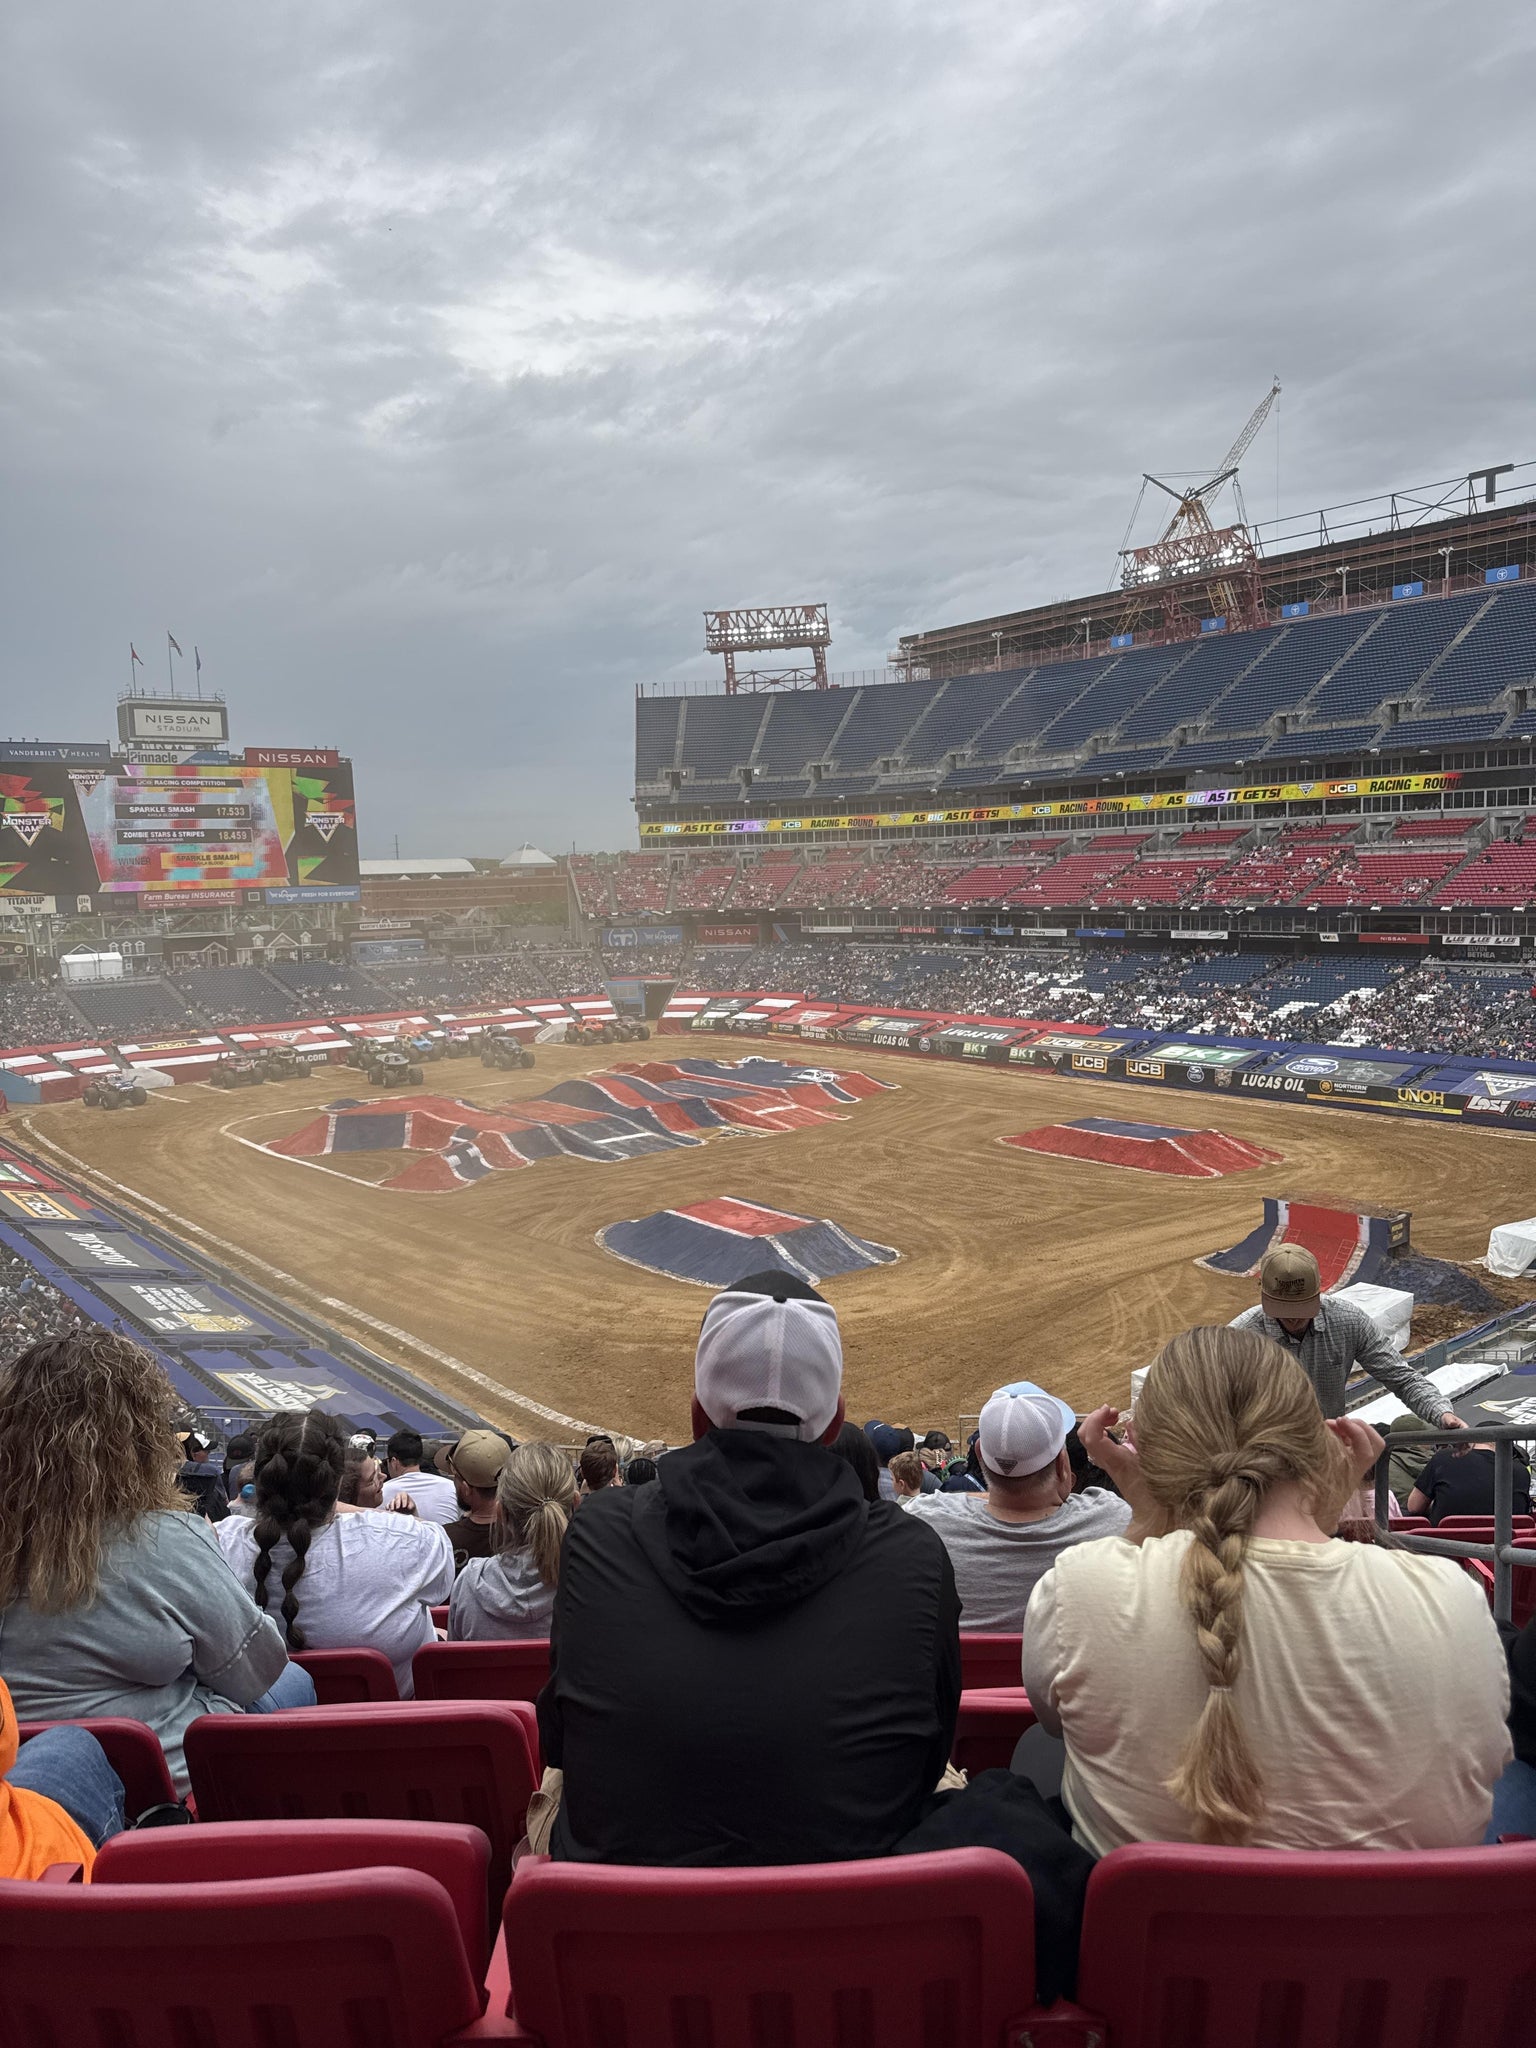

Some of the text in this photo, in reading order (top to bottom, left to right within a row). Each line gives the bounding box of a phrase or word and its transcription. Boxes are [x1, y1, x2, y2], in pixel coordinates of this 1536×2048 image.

[145, 714, 210, 724] NISSAN
[130, 752, 178, 763] Pinnacle
[258, 753, 326, 764] NISSAN
[1330, 784, 1357, 794] JCB
[1370, 779, 1411, 792] RACING
[1166, 788, 1281, 805] AS BIG AS IT GETS!
[216, 807, 245, 816] 17.533
[1060, 802, 1088, 813] RACING
[1096, 802, 1123, 812] ROUND
[973, 810, 1000, 819] GETS!
[713, 823, 745, 831] GETS!
[811, 819, 840, 828] RACING
[848, 818, 873, 826] ROUND
[219, 832, 247, 840] 18.459
[118, 857, 151, 865] WINNER
[873, 1034, 910, 1047] LUCAS OIL
[963, 1042, 987, 1053] BKT
[1010, 1048, 1035, 1058] BKT
[1156, 1046, 1248, 1060] BKT
[1074, 1056, 1105, 1068] JCB
[1129, 1062, 1161, 1075] JCB
[1241, 1074, 1304, 1092] LUCAS OIL
[1398, 1088, 1444, 1104] UNOH
